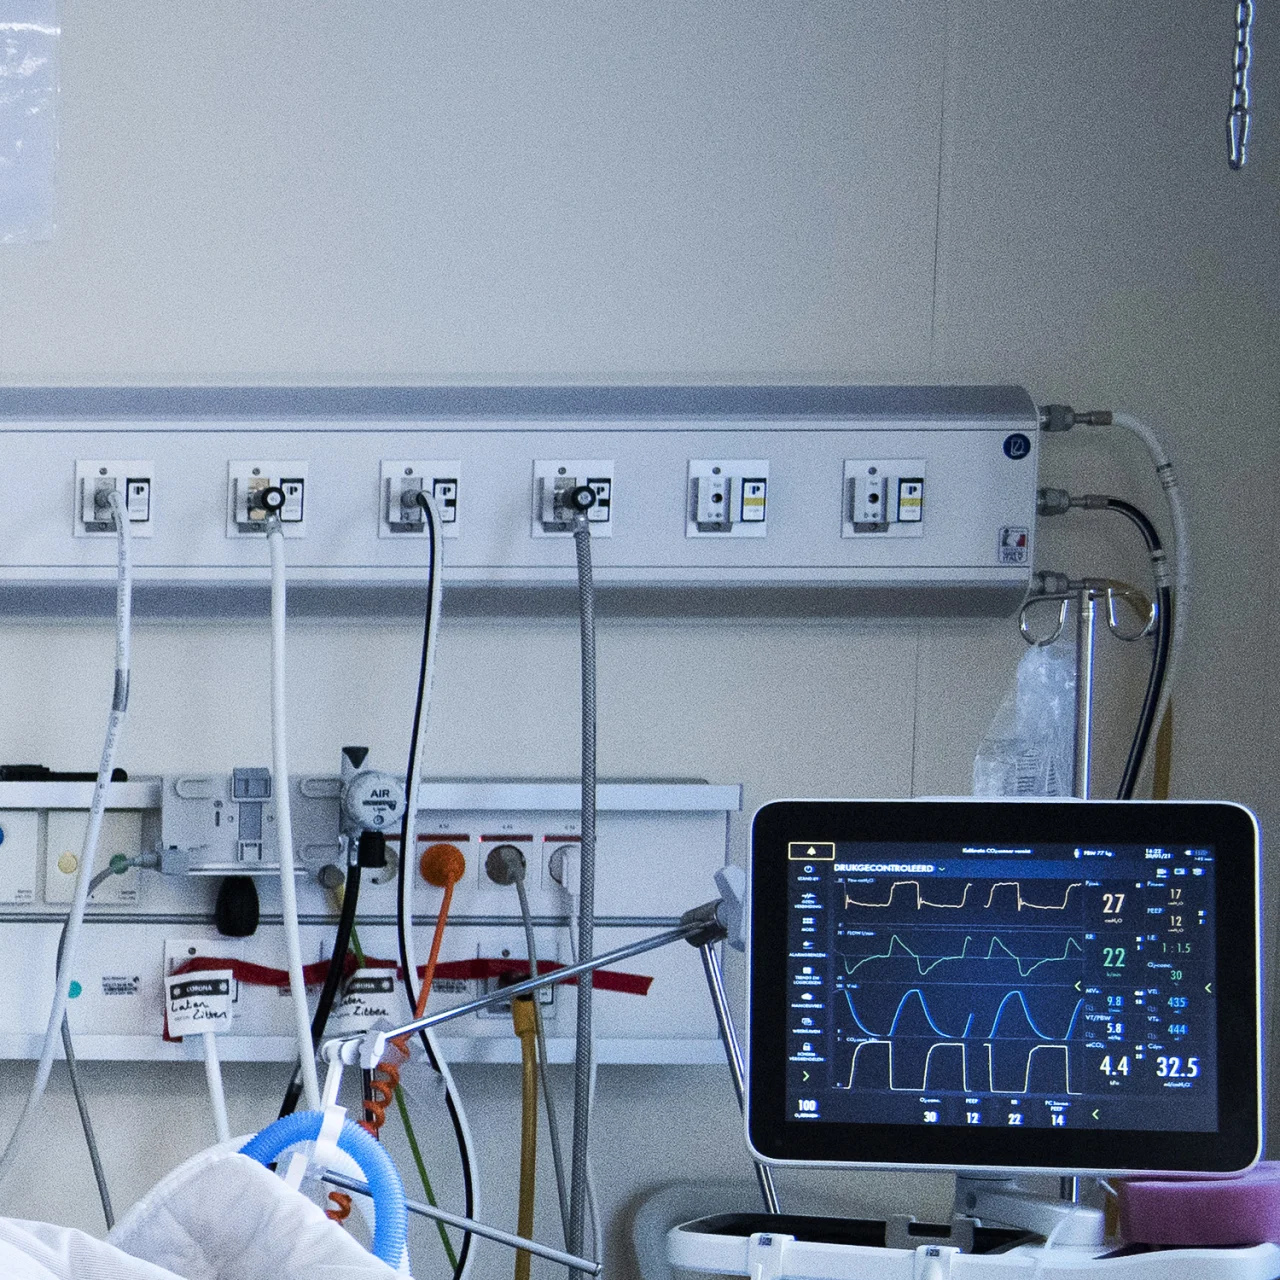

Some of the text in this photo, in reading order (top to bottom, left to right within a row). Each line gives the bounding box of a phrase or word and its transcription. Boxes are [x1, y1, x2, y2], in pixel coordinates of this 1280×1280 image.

[370, 788, 390, 798] AIR
[834, 863, 934, 874] DRUKGECONTROLEERD
[1170, 889, 1182, 900] 17
[1102, 893, 1125, 913] 27
[1170, 916, 1182, 927] 12
[1103, 948, 1126, 967] 22
[1170, 970, 1182, 980] 30
[186, 985, 212, 993] CORONA
[1107, 996, 1122, 1006] 9.8
[1167, 997, 1186, 1007] 435
[1106, 1023, 1122, 1034] 5.8
[1167, 1024, 1186, 1034] 444
[1099, 1055, 1129, 1076] 4.4
[1156, 1056, 1200, 1078] 32.5
[798, 1100, 816, 1111] 100
[923, 1112, 937, 1123] 30
[966, 1113, 979, 1124] 12
[1008, 1114, 1022, 1125] 22
[1051, 1115, 1064, 1125] 14
